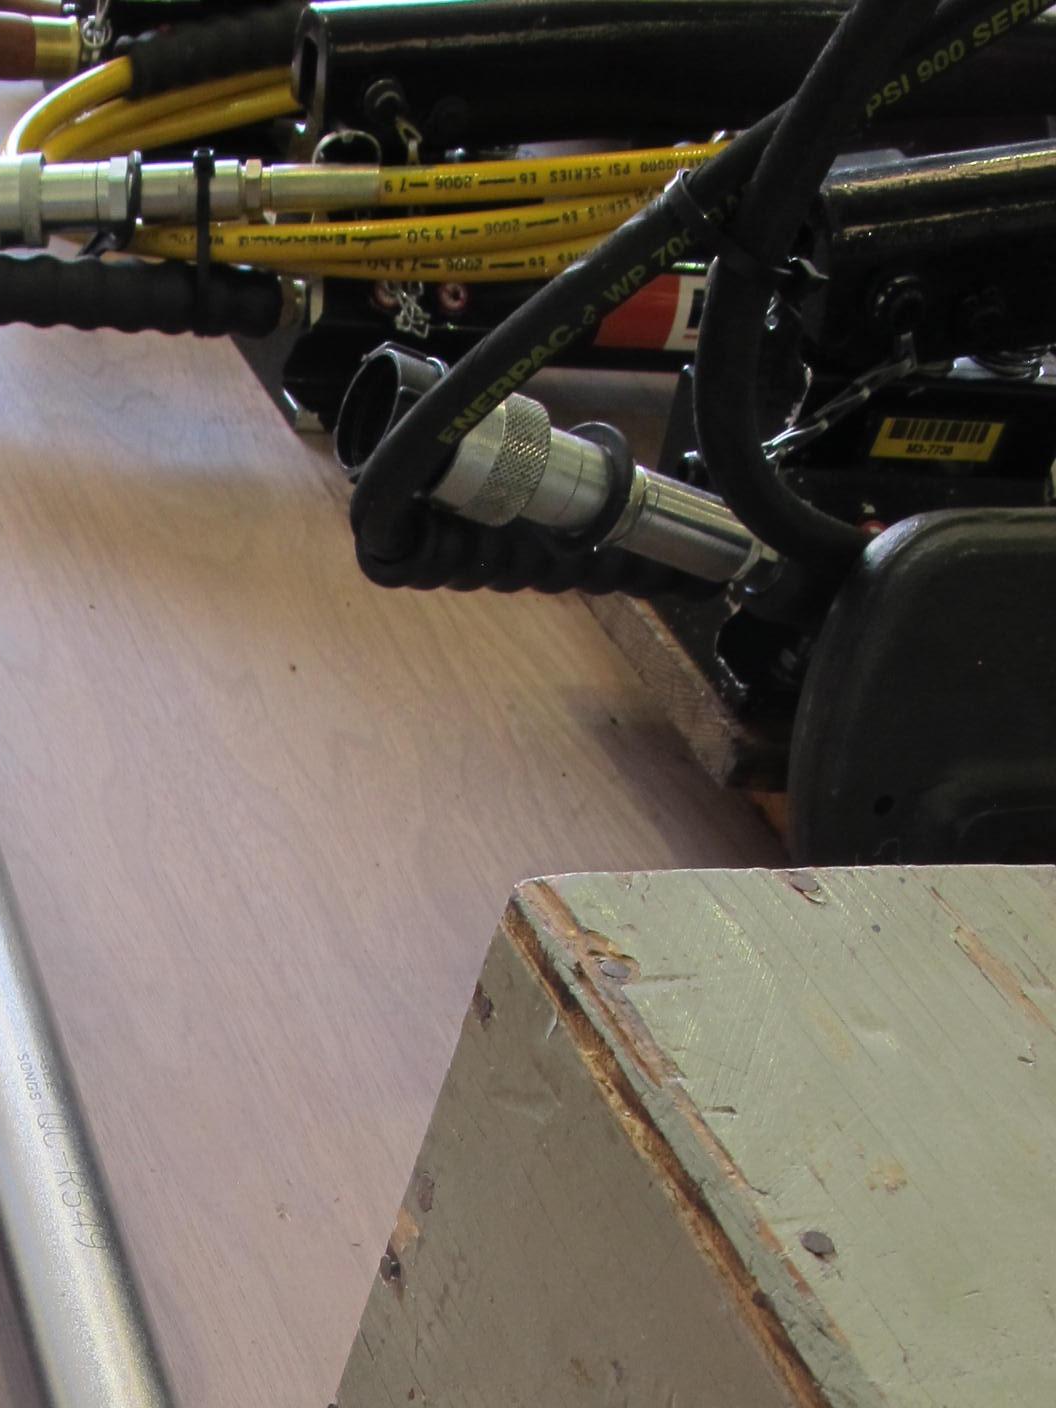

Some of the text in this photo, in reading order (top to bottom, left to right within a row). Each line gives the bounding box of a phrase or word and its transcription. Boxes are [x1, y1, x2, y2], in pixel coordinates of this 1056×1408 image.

[865, 73, 910, 118] PSI
[917, 39, 965, 83] 900
[434, 175, 473, 191] 2006
[548, 166, 602, 184] SERIES
[446, 257, 484, 273] 2006
[602, 262, 646, 304] WP
